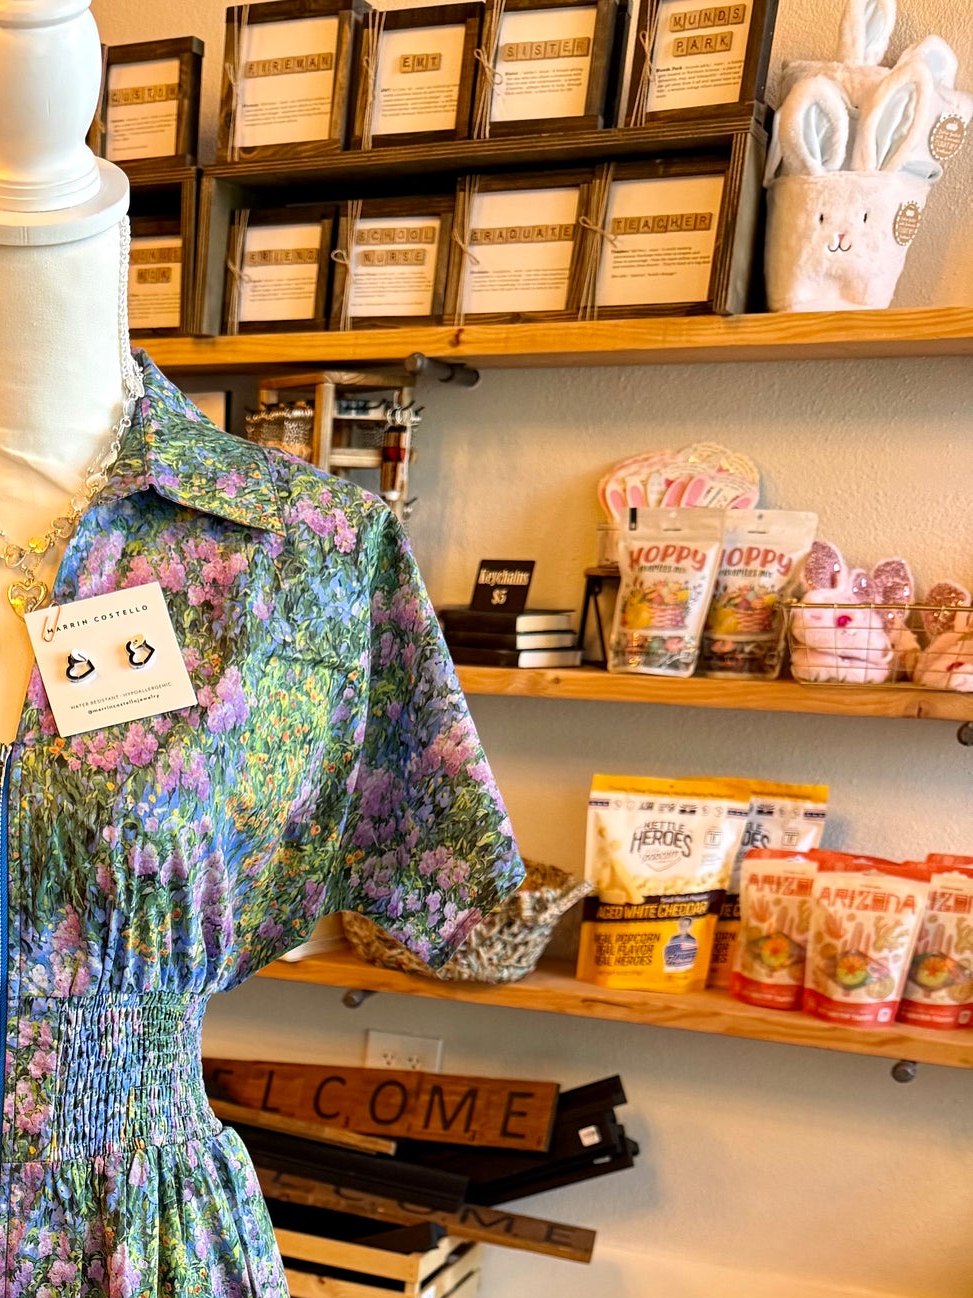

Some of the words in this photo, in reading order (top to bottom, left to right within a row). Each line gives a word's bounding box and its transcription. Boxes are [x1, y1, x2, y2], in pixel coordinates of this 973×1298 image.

[672, 7, 742, 29] MUNDS
[505, 40, 586, 58] SISTER
[675, 36, 730, 54] PARK
[248, 54, 331, 75] FIREMAN
[402, 56, 438, 70] EMT
[614, 214, 710, 233] TEACHER
[358, 227, 433, 243] SCHOOL
[470, 225, 572, 242] GRADUATE
[362, 250, 424, 264] NURSE
[629, 544, 707, 572] HOPPY
[478, 568, 530, 586] Keychains
[46, 619, 88, 635] MARRIN
[93, 604, 149, 623] COSTELLO
[643, 821, 686, 833] KETTLE
[630, 829, 694, 858] HEROES
[596, 905, 623, 919] AGED
[624, 904, 657, 918] WHITE
[657, 900, 710, 917] CHEDDAR
[615, 932, 661, 944] POPCORN
[617, 944, 655, 955] FLAVOR
[614, 955, 653, 967] HEROES
